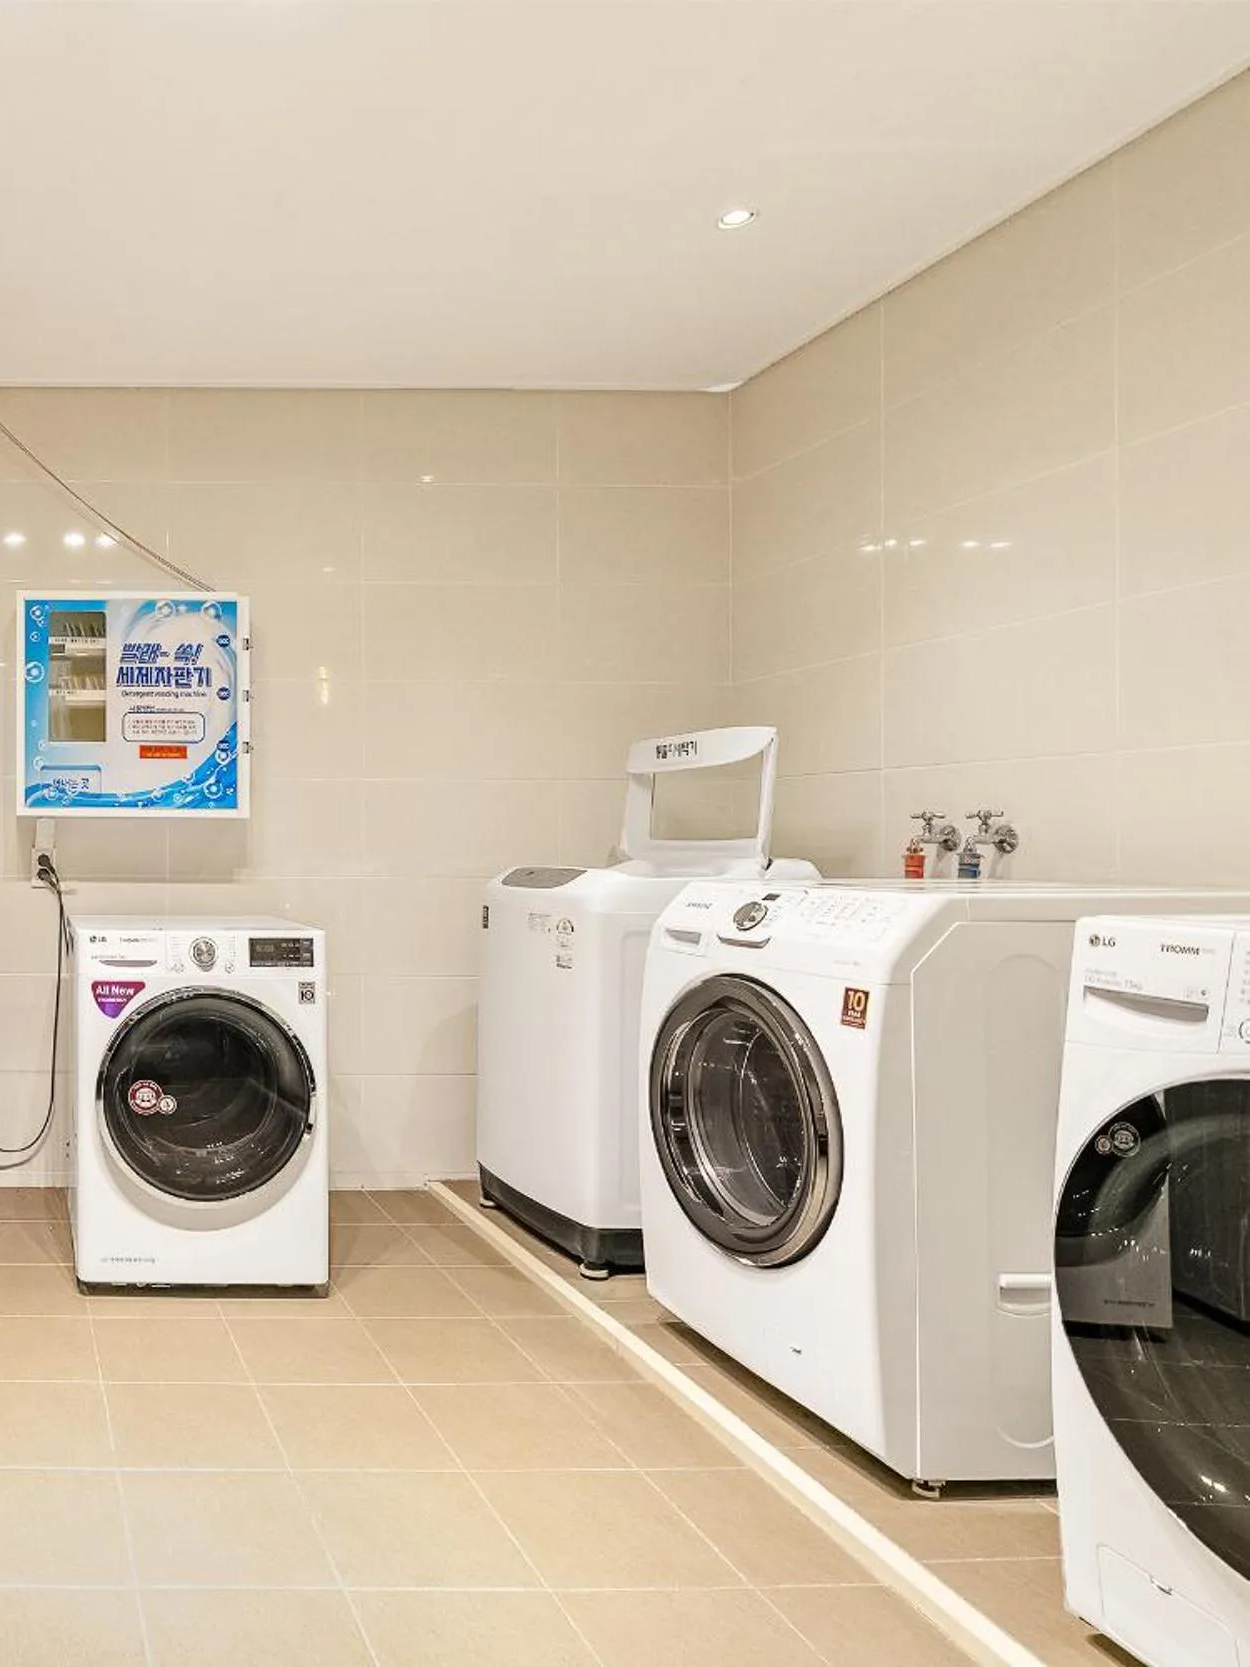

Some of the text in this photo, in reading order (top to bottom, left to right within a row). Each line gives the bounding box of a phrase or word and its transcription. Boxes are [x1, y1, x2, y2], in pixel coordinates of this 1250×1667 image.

[116, 666, 213, 688] 세제자판기
[96, 985, 135, 996] All New
[847, 990, 866, 1011] 10
